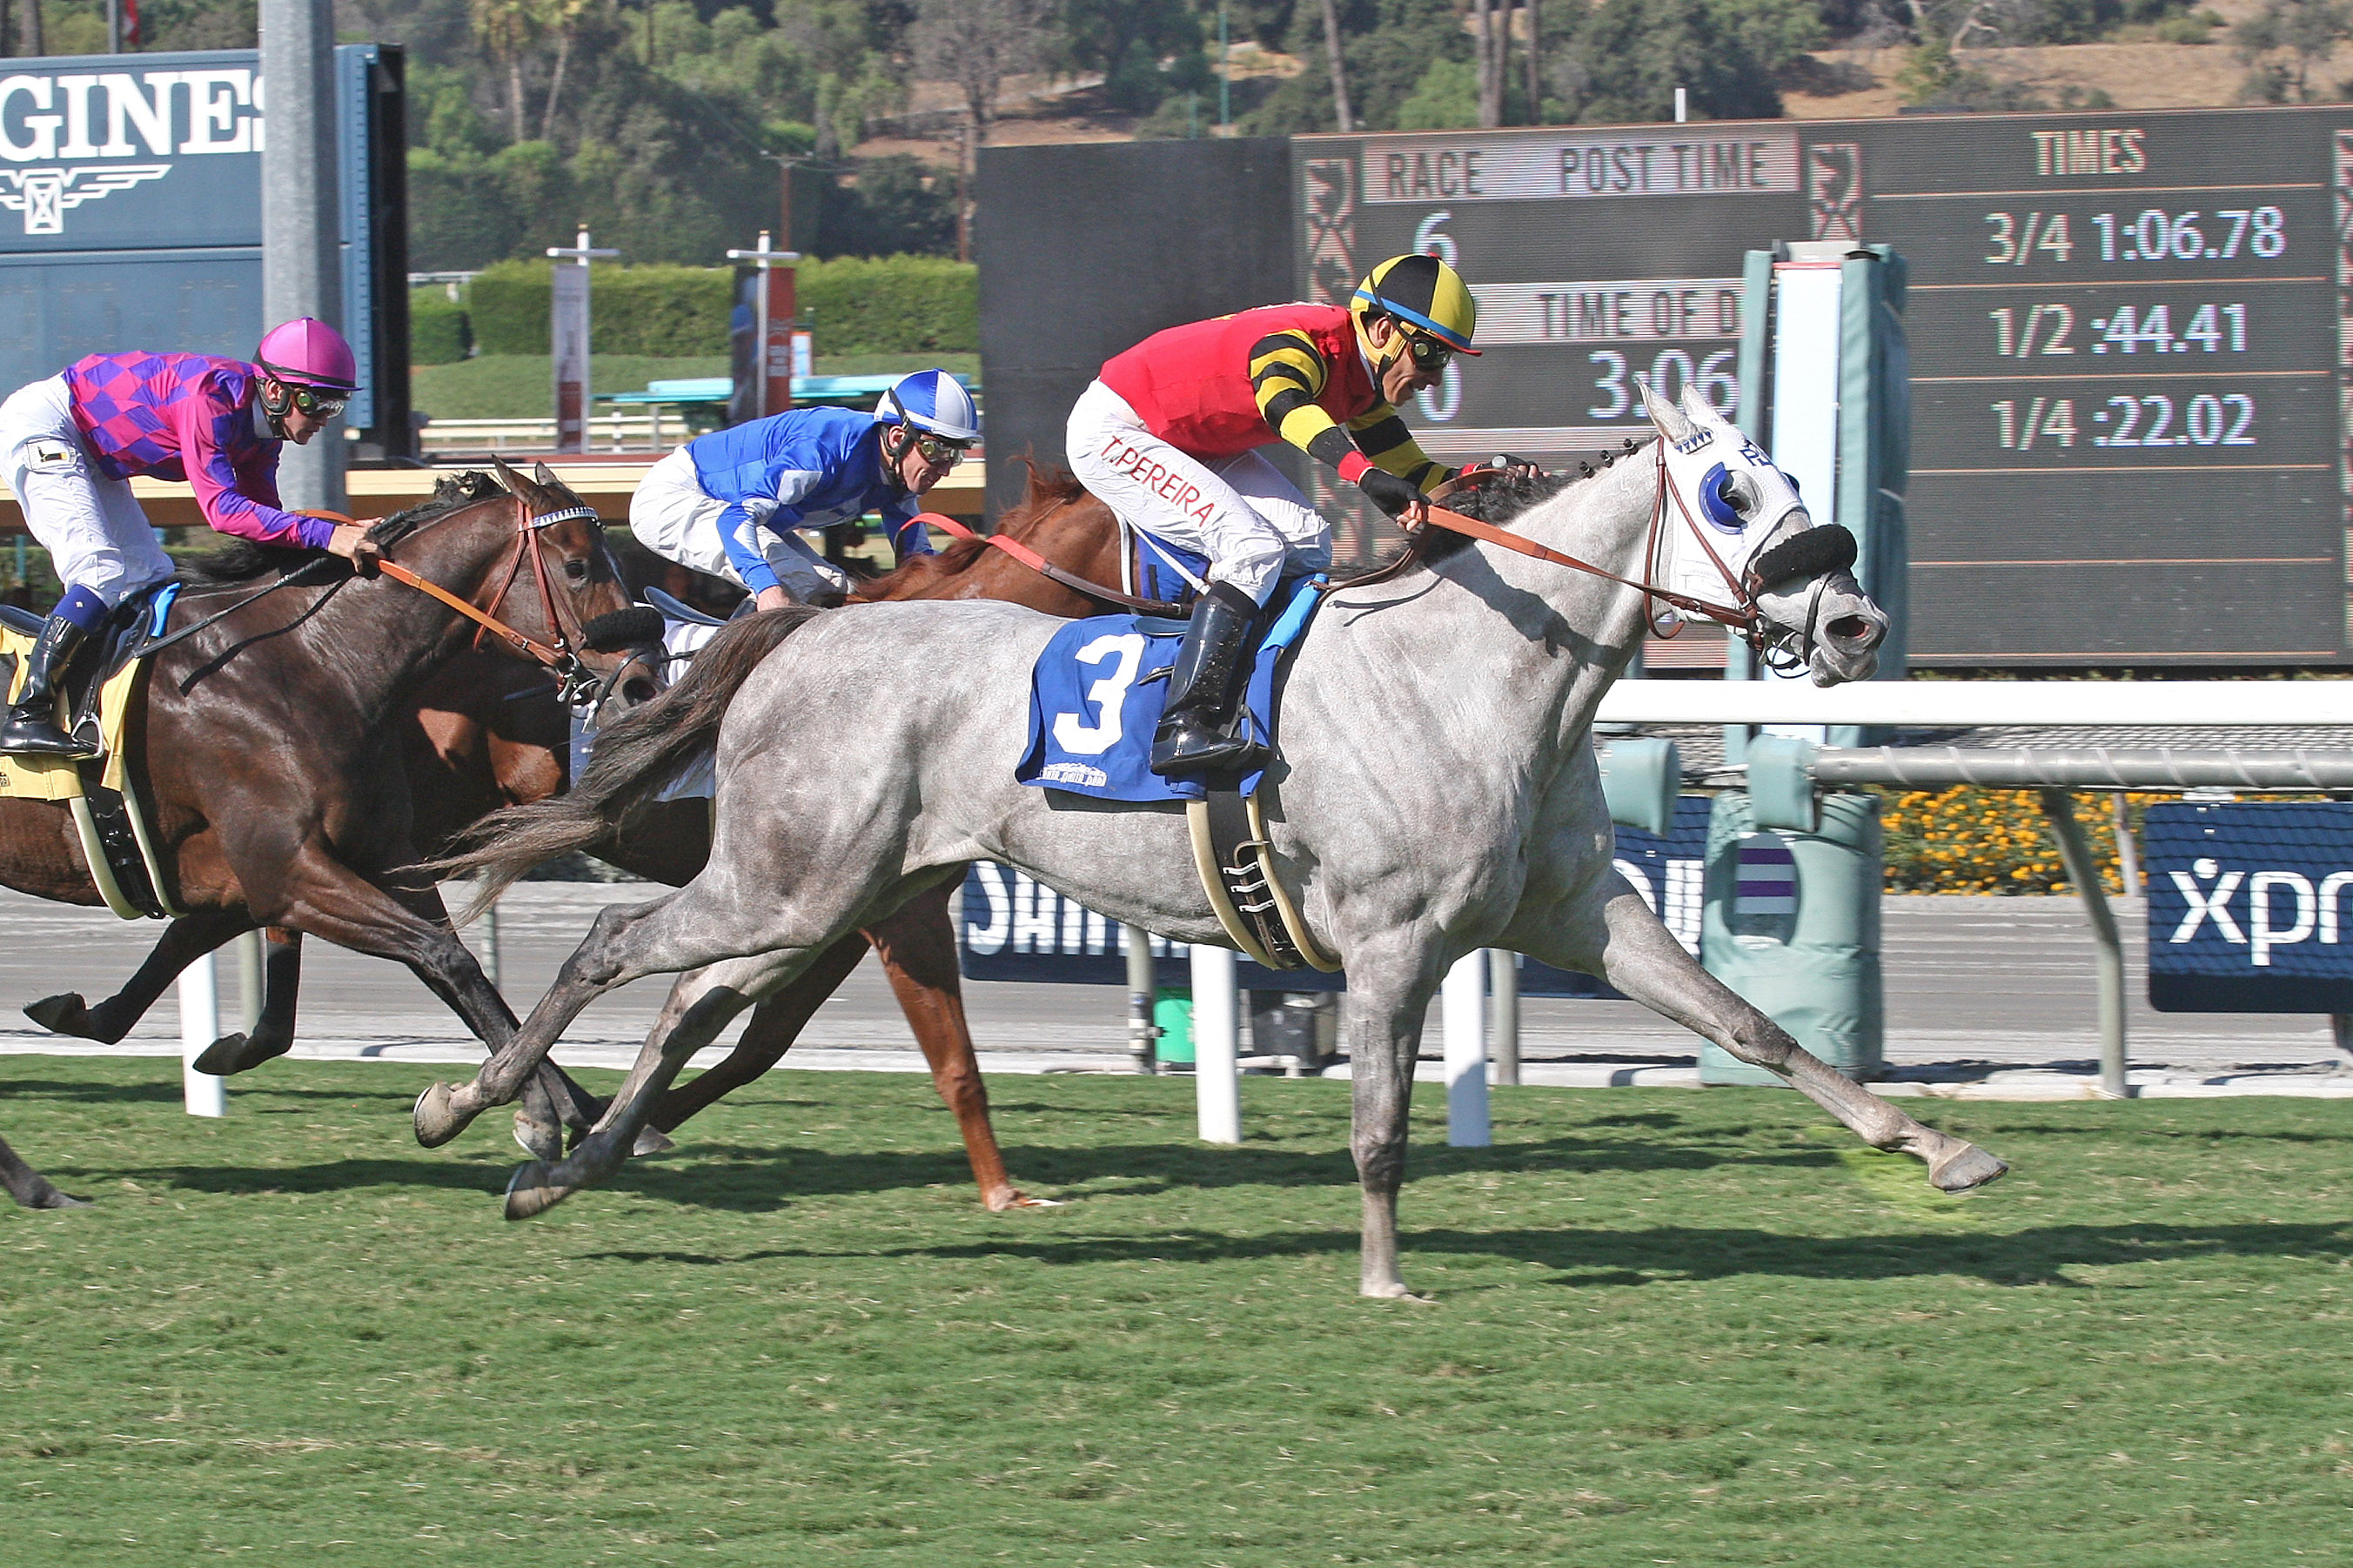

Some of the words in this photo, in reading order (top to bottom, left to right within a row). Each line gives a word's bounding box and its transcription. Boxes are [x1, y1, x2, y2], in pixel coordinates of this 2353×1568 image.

[1387, 151, 1483, 198] RACE
[1559, 146, 1655, 193] POST
[1672, 142, 1769, 190] TIME
[2031, 129, 2147, 174] TIMES
[1412, 210, 1458, 269] 6
[1984, 211, 2075, 265] 3/4
[2091, 205, 2287, 261] 1:06.78
[1538, 292, 1634, 338] TIME
[1652, 291, 1699, 335] OF
[1988, 304, 2076, 358] 1/2
[2090, 303, 2247, 353] :44.41
[1588, 349, 1740, 419] 3:06
[1990, 397, 2079, 451] 1/4
[2093, 394, 2257, 446] :22.02
[1101, 435, 1215, 527] T.PEREIRA
[1052, 633, 1146, 754] 3
